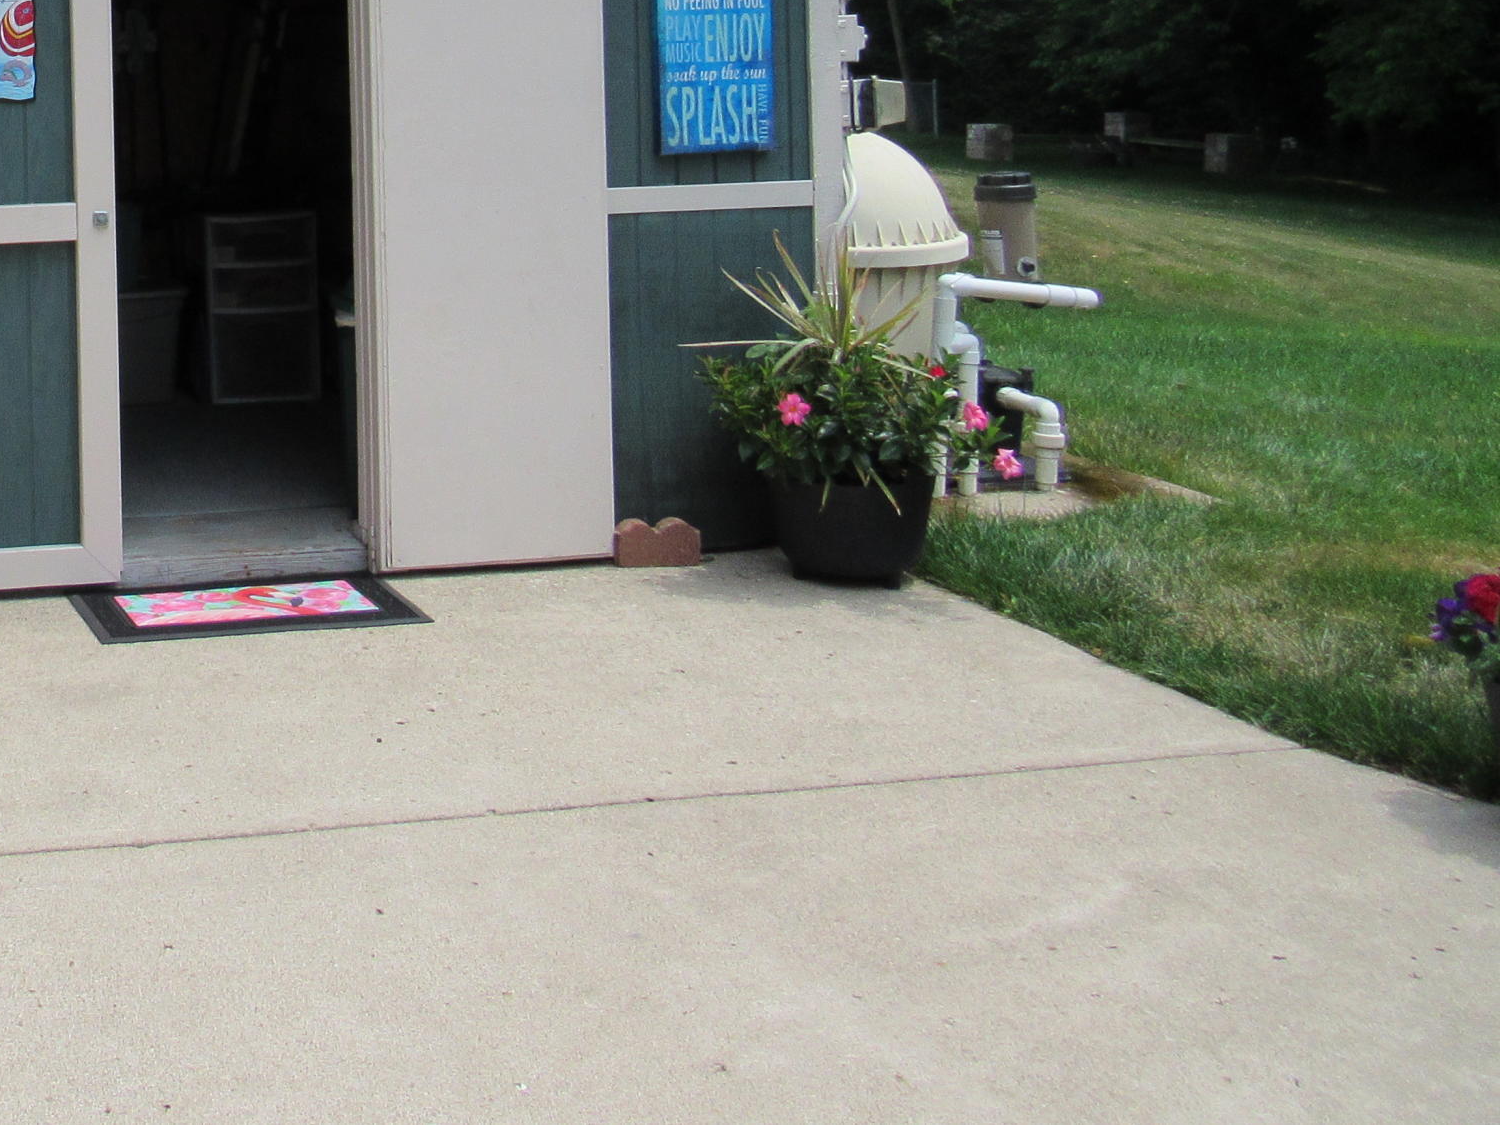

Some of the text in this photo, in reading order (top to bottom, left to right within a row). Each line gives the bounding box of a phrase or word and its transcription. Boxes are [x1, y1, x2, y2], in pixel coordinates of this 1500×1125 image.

[665, 15, 701, 42] PLAY
[704, 13, 765, 63] ENJOY
[665, 42, 702, 63] MUSIC
[666, 63, 766, 86] soak up the sun
[666, 84, 760, 147] SPLASH
[758, 84, 769, 144] HAVE FUN
